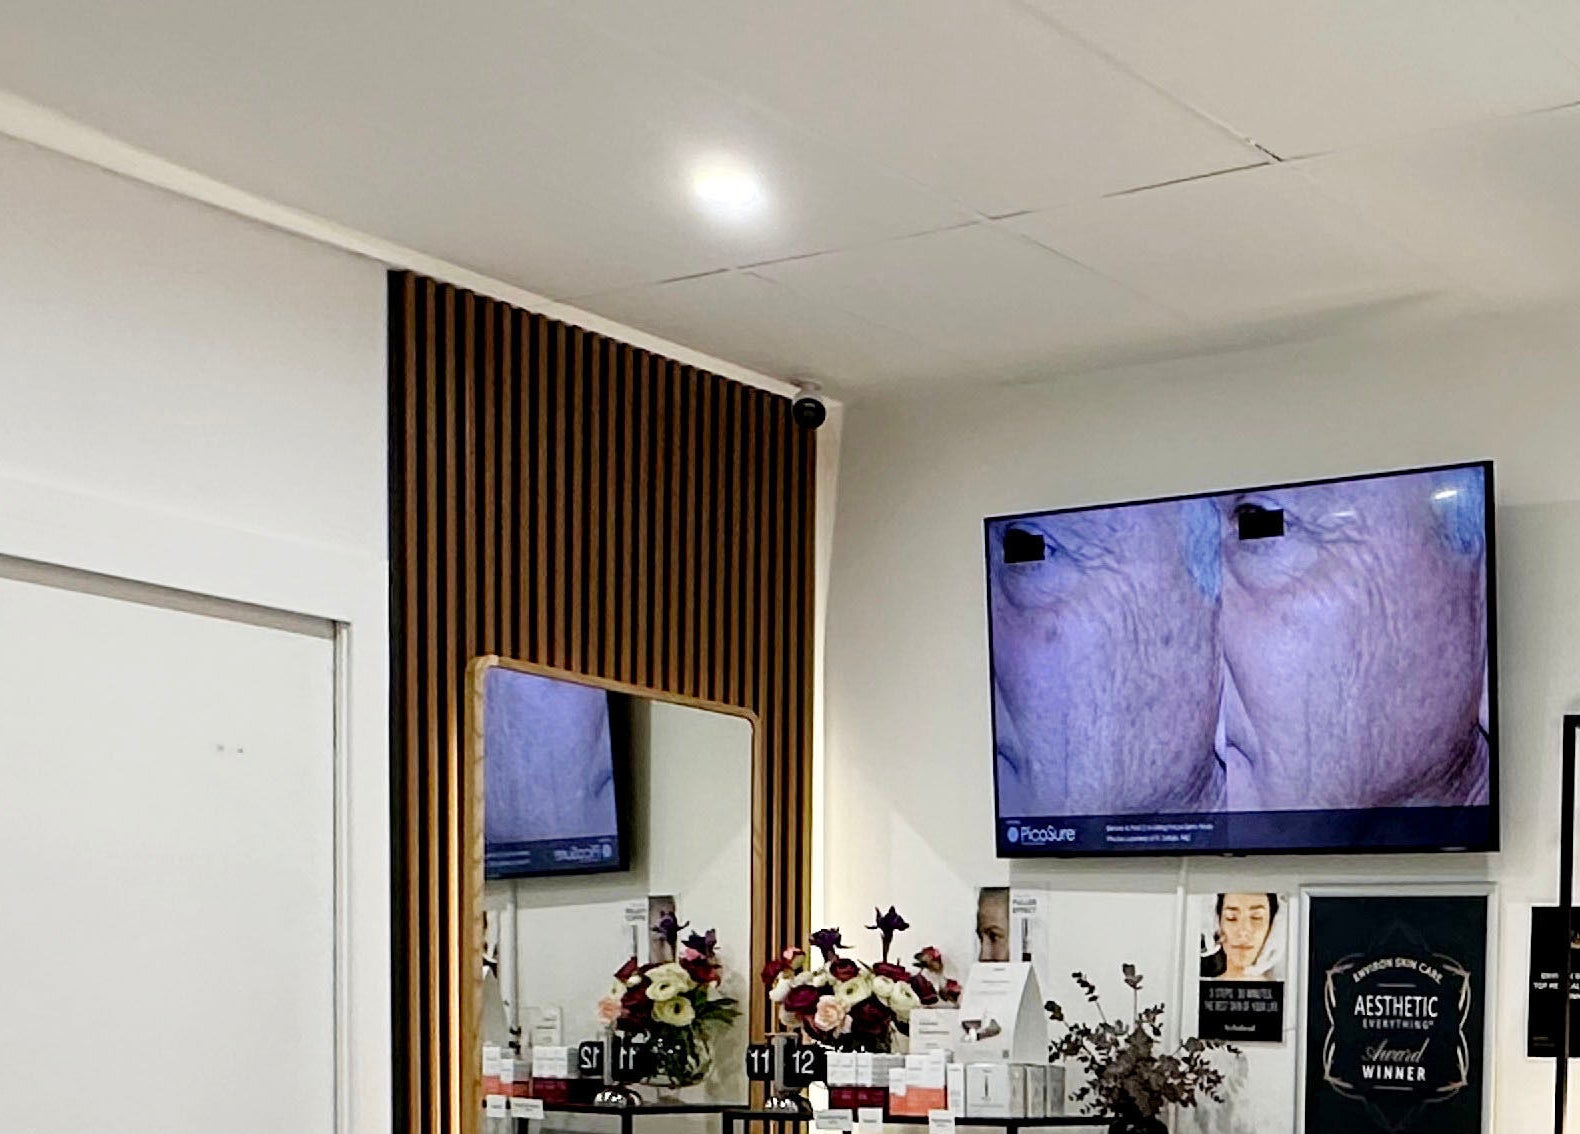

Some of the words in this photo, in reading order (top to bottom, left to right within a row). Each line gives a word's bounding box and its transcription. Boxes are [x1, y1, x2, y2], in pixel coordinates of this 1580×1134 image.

[1021, 827, 1076, 841] PicoSure
[1418, 962, 1444, 985] CARE
[1354, 994, 1439, 1018] AESTHETIC
[751, 1049, 769, 1073] 11
[792, 1050, 814, 1074] 12
[1362, 1065, 1426, 1081] WINNER
